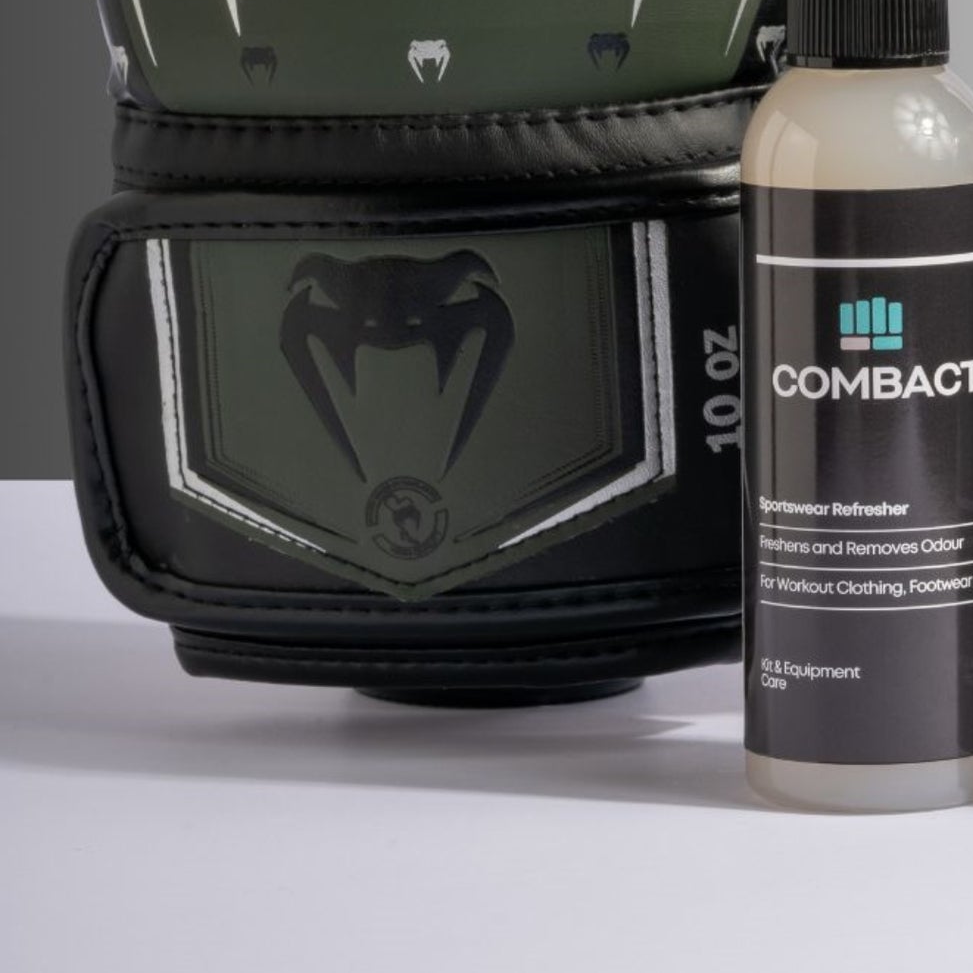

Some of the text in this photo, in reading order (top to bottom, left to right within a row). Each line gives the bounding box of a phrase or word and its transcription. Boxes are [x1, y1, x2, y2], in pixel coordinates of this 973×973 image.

[703, 394, 744, 453] 10
[759, 495, 909, 516] Sportswear Refresher
[759, 535, 965, 555] Freshens and Removes Odour
[760, 574, 776, 589] For
[776, 576, 834, 594] Workout
[836, 580, 907, 597] Clothing,
[909, 574, 973, 593] Footwear
[761, 658, 861, 680] Kit & Equipment
[761, 673, 787, 690] Care
